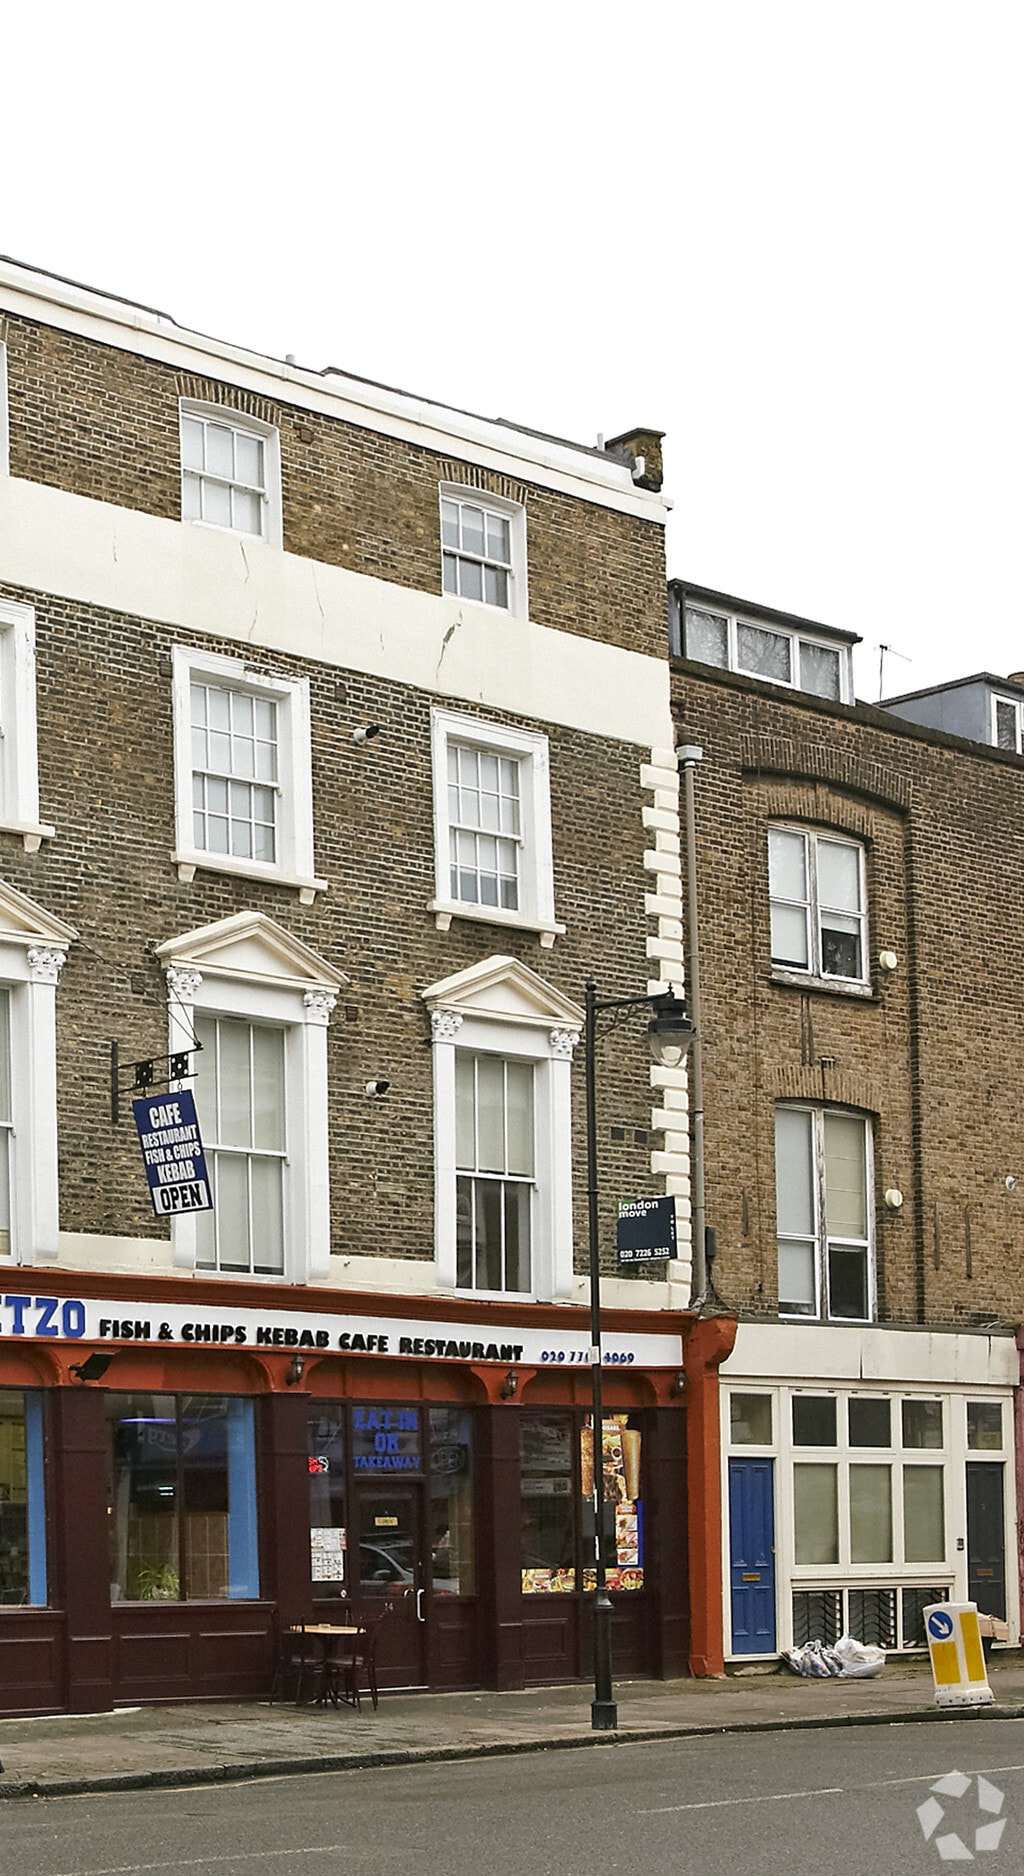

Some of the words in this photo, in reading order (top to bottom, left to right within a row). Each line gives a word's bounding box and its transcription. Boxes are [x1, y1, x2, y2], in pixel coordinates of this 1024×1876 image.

[149, 1102, 182, 1129] CAFE
[141, 1124, 197, 1149] RESTAURANT
[145, 1148, 166, 1165] FISH
[166, 1148, 173, 1161] &
[173, 1141, 201, 1160] CHIPS
[157, 1160, 195, 1184] KEBAB
[160, 1183, 203, 1211] OPEN
[618, 1200, 659, 1211] london
[618, 1210, 647, 1219] move
[619, 1250, 633, 1258] 020
[654, 1247, 670, 1256] 5252
[99, 1318, 151, 1340] FISH
[158, 1323, 174, 1341] &
[181, 1323, 248, 1344] CHIPS
[256, 1326, 330, 1349] KEBAB
[339, 1332, 389, 1354] CAFE
[399, 1337, 524, 1362] RESTAURANT
[541, 1351, 565, 1361] 020
[604, 1352, 634, 1364] 4069
[354, 1409, 393, 1429] EAT
[397, 1411, 418, 1431] IN
[375, 1433, 400, 1453] OR
[354, 1455, 420, 1468] TAKEAWAY
